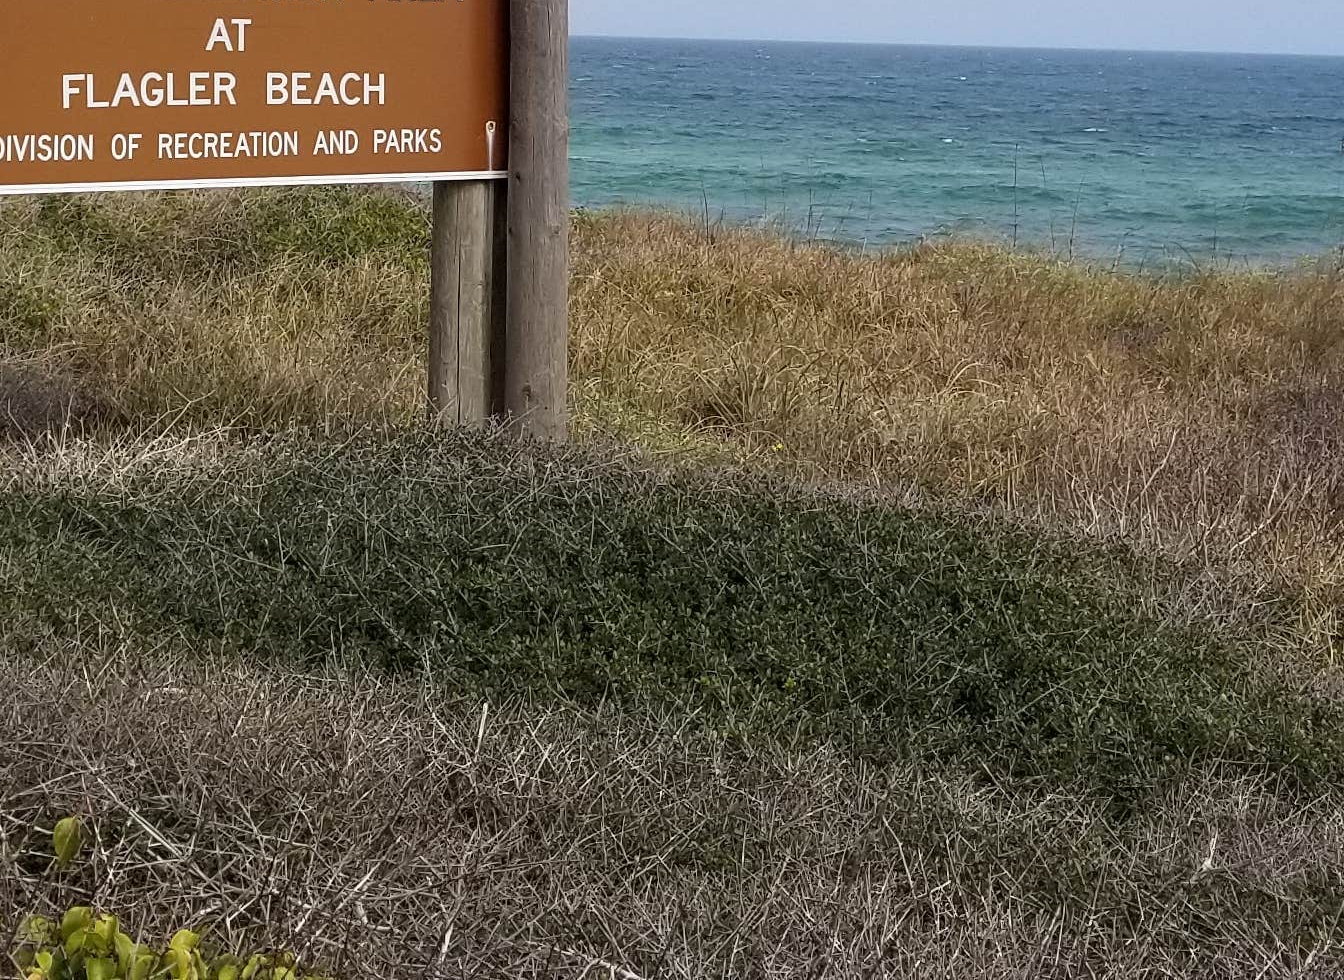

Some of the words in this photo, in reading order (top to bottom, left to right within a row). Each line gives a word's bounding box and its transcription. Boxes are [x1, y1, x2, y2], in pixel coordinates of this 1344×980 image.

[205, 17, 252, 52] AT
[62, 71, 237, 109] FLAGLER
[266, 72, 385, 106] BEACH
[111, 133, 143, 160] OF
[158, 130, 298, 159] RECREATION
[312, 129, 359, 156] AND
[373, 128, 442, 154] PARKS
